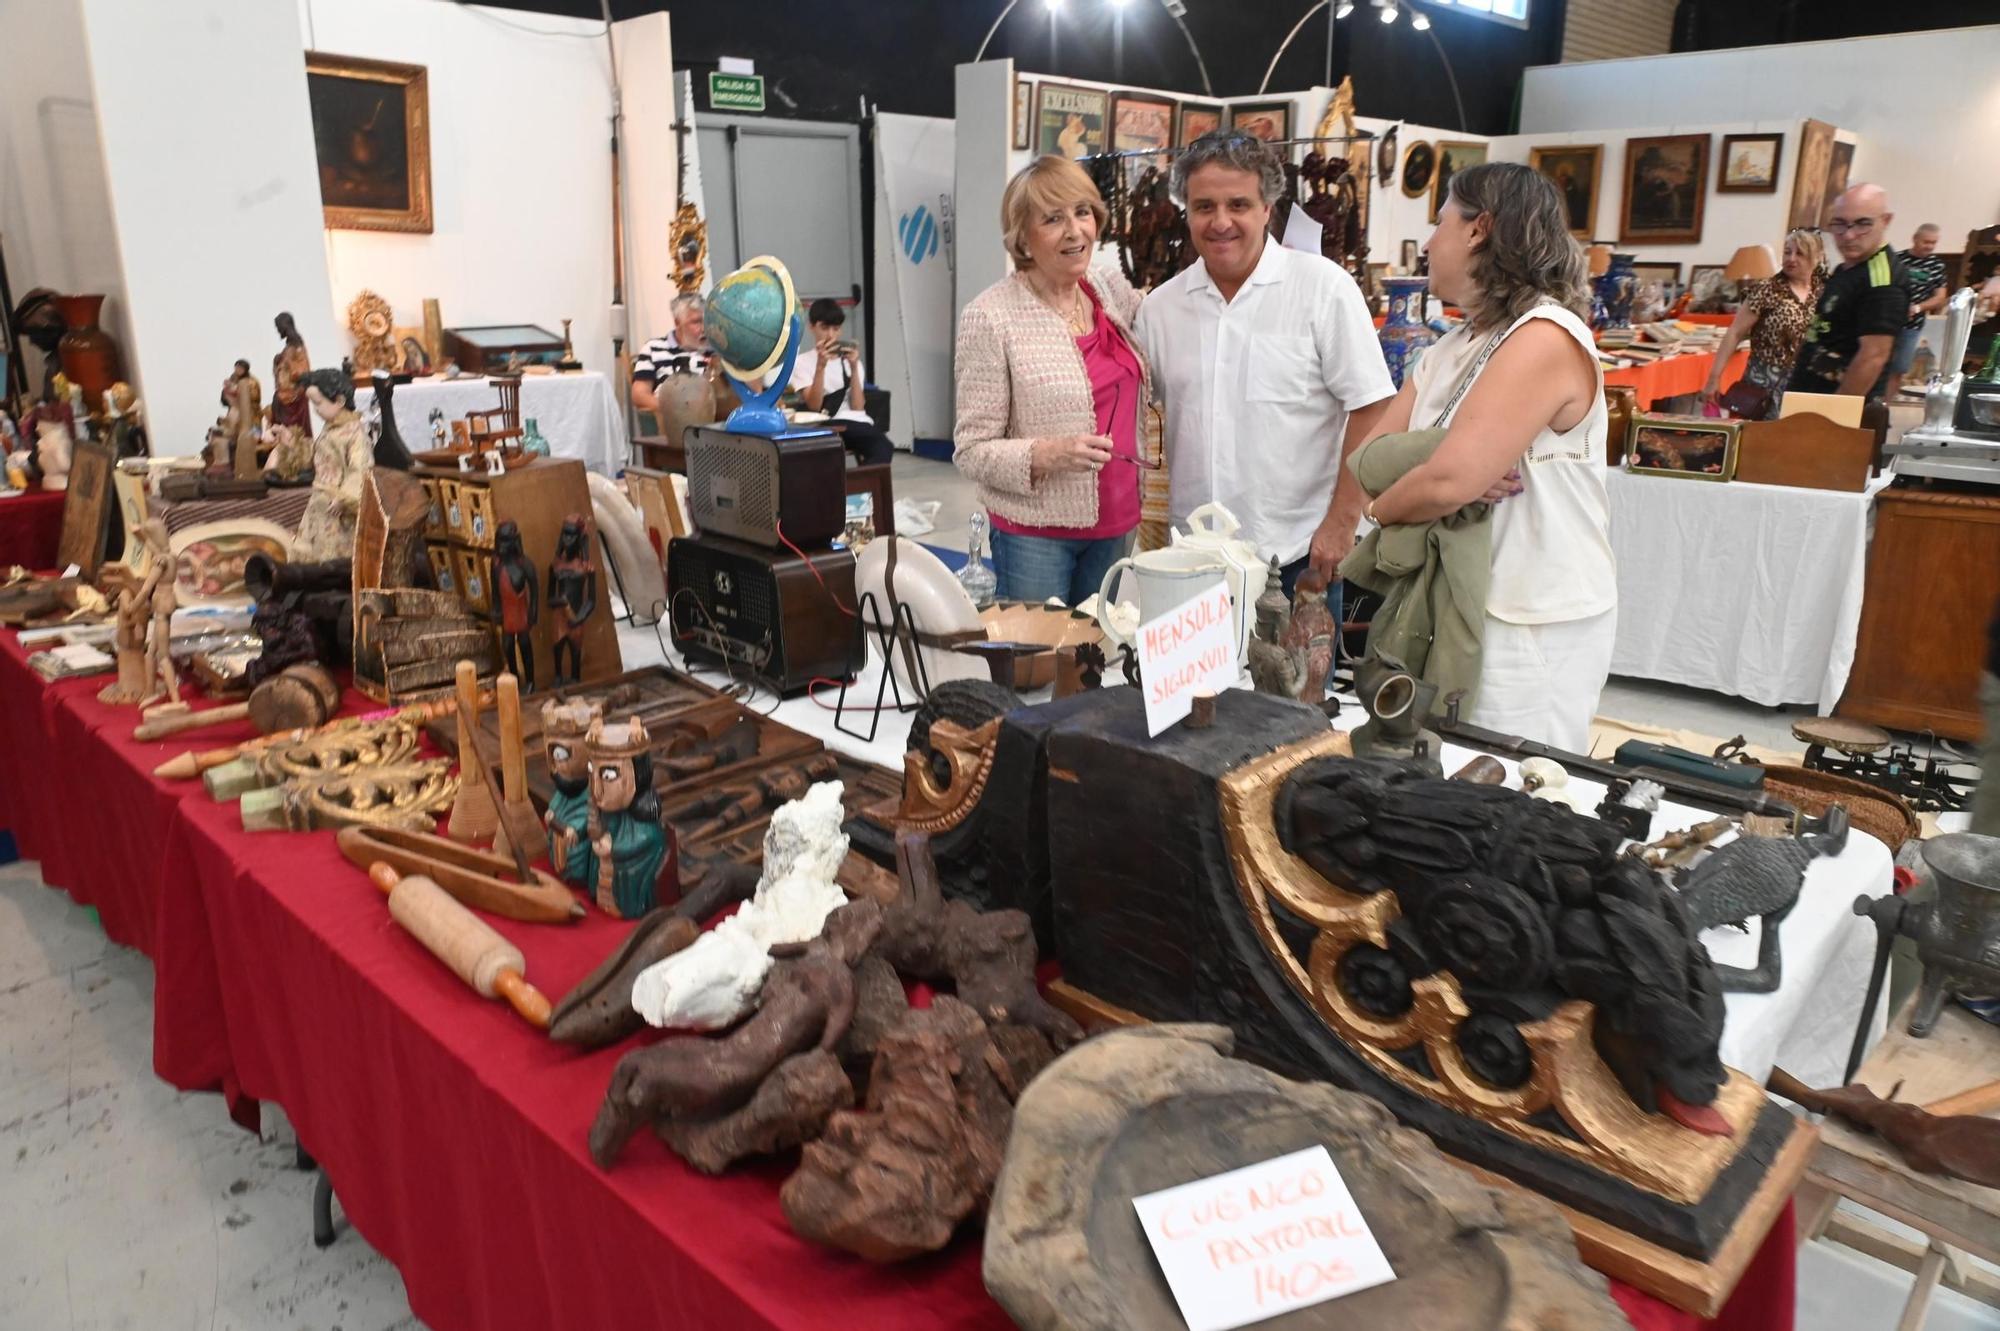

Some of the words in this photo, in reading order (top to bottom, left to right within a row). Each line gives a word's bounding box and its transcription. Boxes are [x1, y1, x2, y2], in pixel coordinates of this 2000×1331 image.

[717, 80, 744, 90] SALIDA
[745, 82, 755, 92] DE
[713, 92, 761, 104] EMERGENCIA
[1043, 90, 1104, 115] EXCELSIOR
[1160, 1167, 1326, 1241] CUENCO
